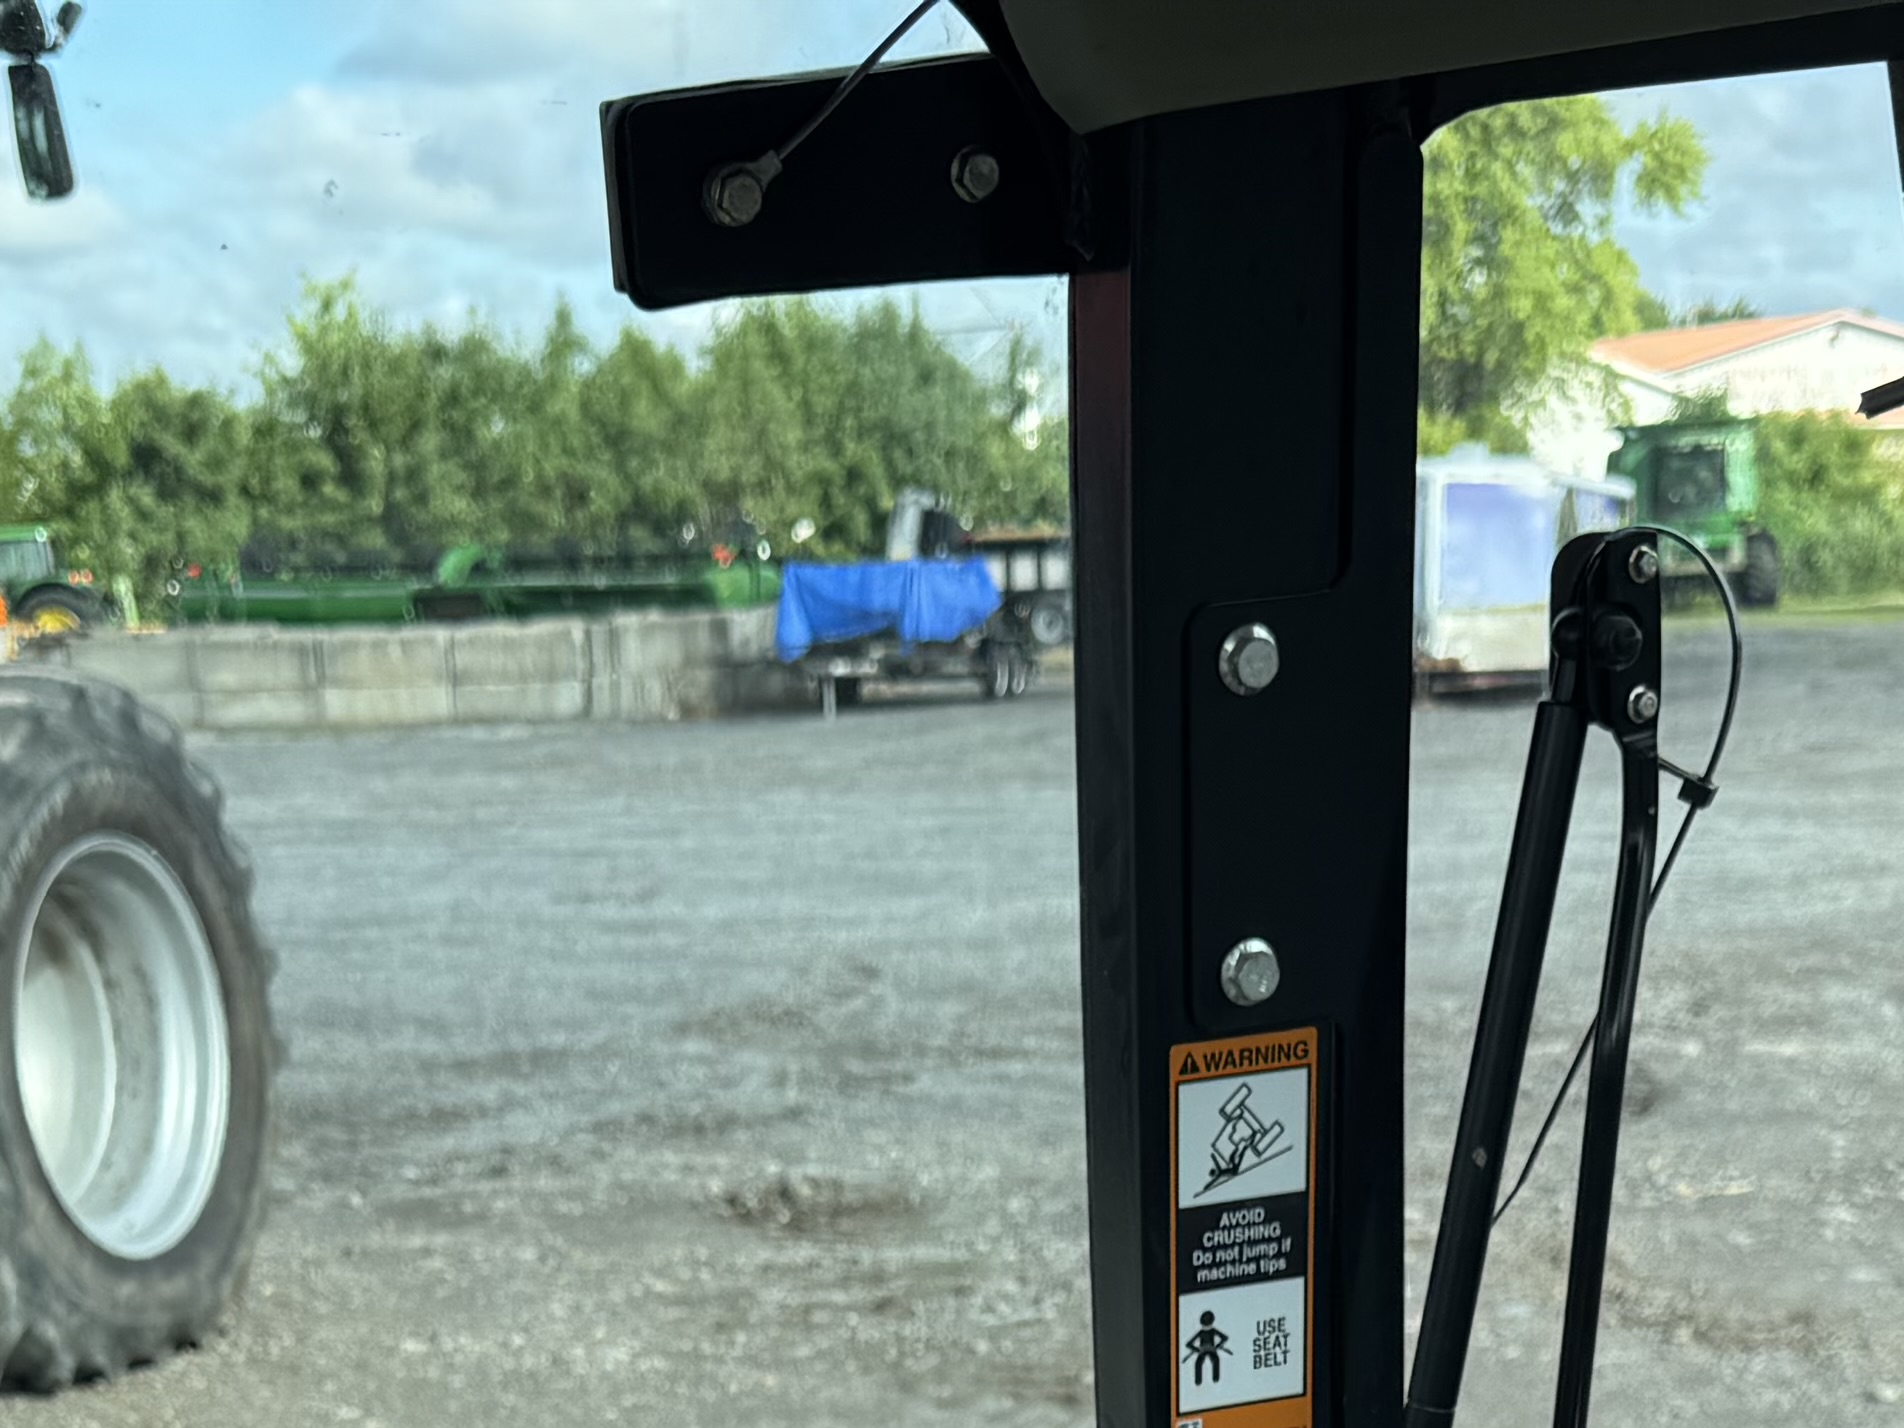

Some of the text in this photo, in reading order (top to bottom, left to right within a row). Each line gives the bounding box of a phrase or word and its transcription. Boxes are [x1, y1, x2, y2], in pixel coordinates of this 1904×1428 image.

[1203, 1039, 1310, 1073] WARNING
[1219, 1205, 1266, 1228] AVOID
[1202, 1221, 1281, 1248] CRUSHING
[1192, 1237, 1292, 1267] Do not jump if
[1197, 1256, 1287, 1283] machine tips
[1256, 1316, 1286, 1336] USE
[1252, 1332, 1291, 1354] SEAT
[1252, 1349, 1291, 1370] BELT
